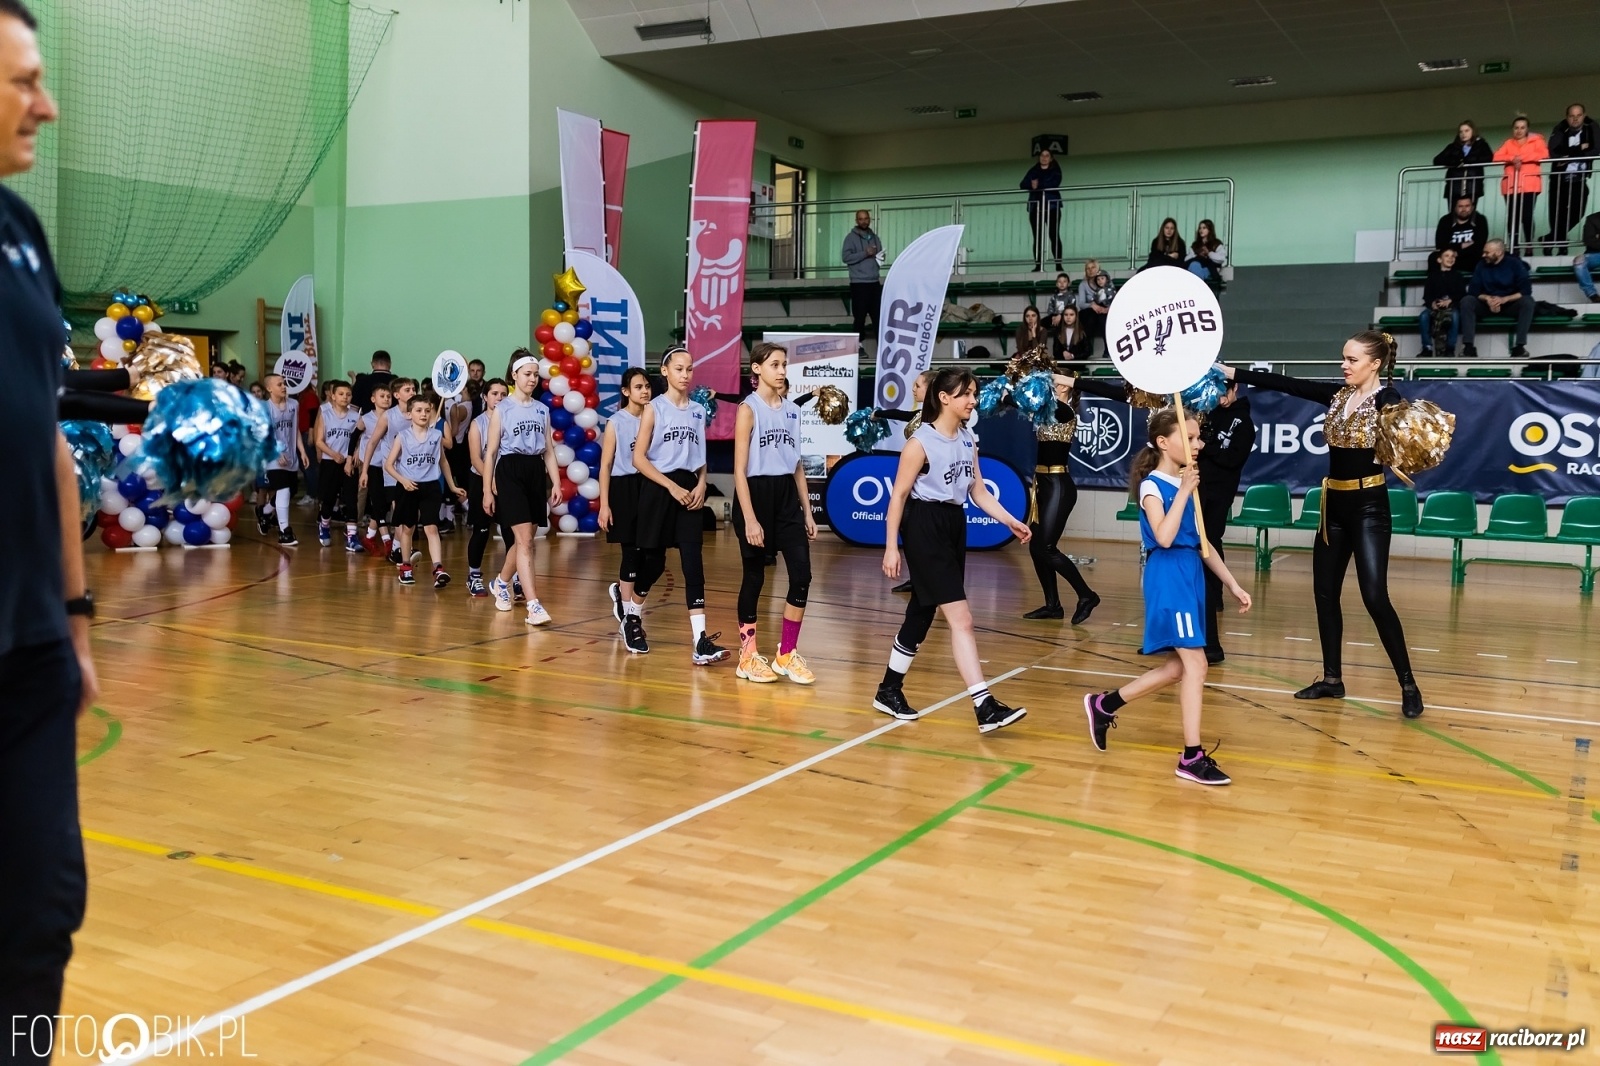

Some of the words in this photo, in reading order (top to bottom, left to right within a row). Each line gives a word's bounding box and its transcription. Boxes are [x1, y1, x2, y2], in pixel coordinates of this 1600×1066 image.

[1125, 314, 1145, 331] SAN
[1148, 299, 1196, 319] ANTONIO
[915, 303, 937, 371] RACIBÓRZ
[1115, 310, 1217, 362] SPURS
[806, 368, 853, 378] BROOKLYN
[1508, 411, 1600, 458] OS
[851, 511, 884, 521] Official
